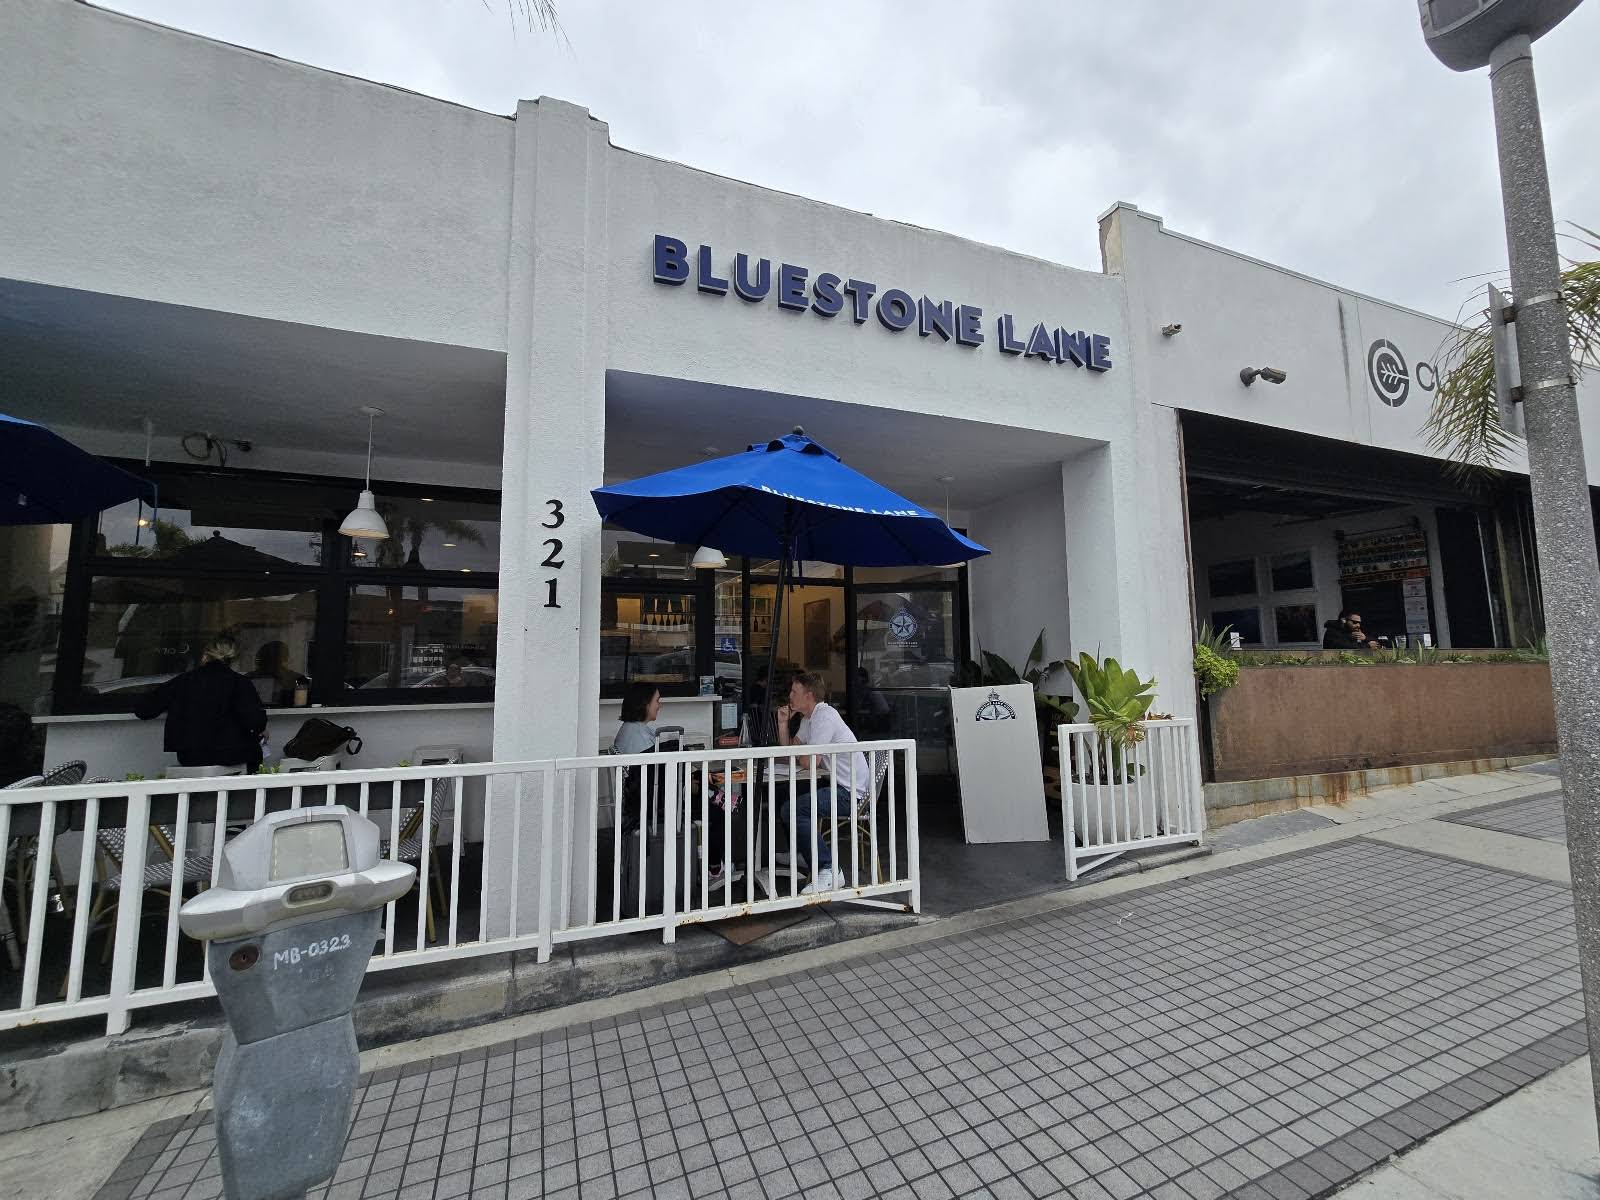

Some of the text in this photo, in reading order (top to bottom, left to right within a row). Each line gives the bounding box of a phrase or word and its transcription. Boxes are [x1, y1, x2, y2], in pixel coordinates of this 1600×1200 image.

[653, 234, 1113, 373] BLUESTONE LANE
[273, 934, 352, 970] MB-0323
